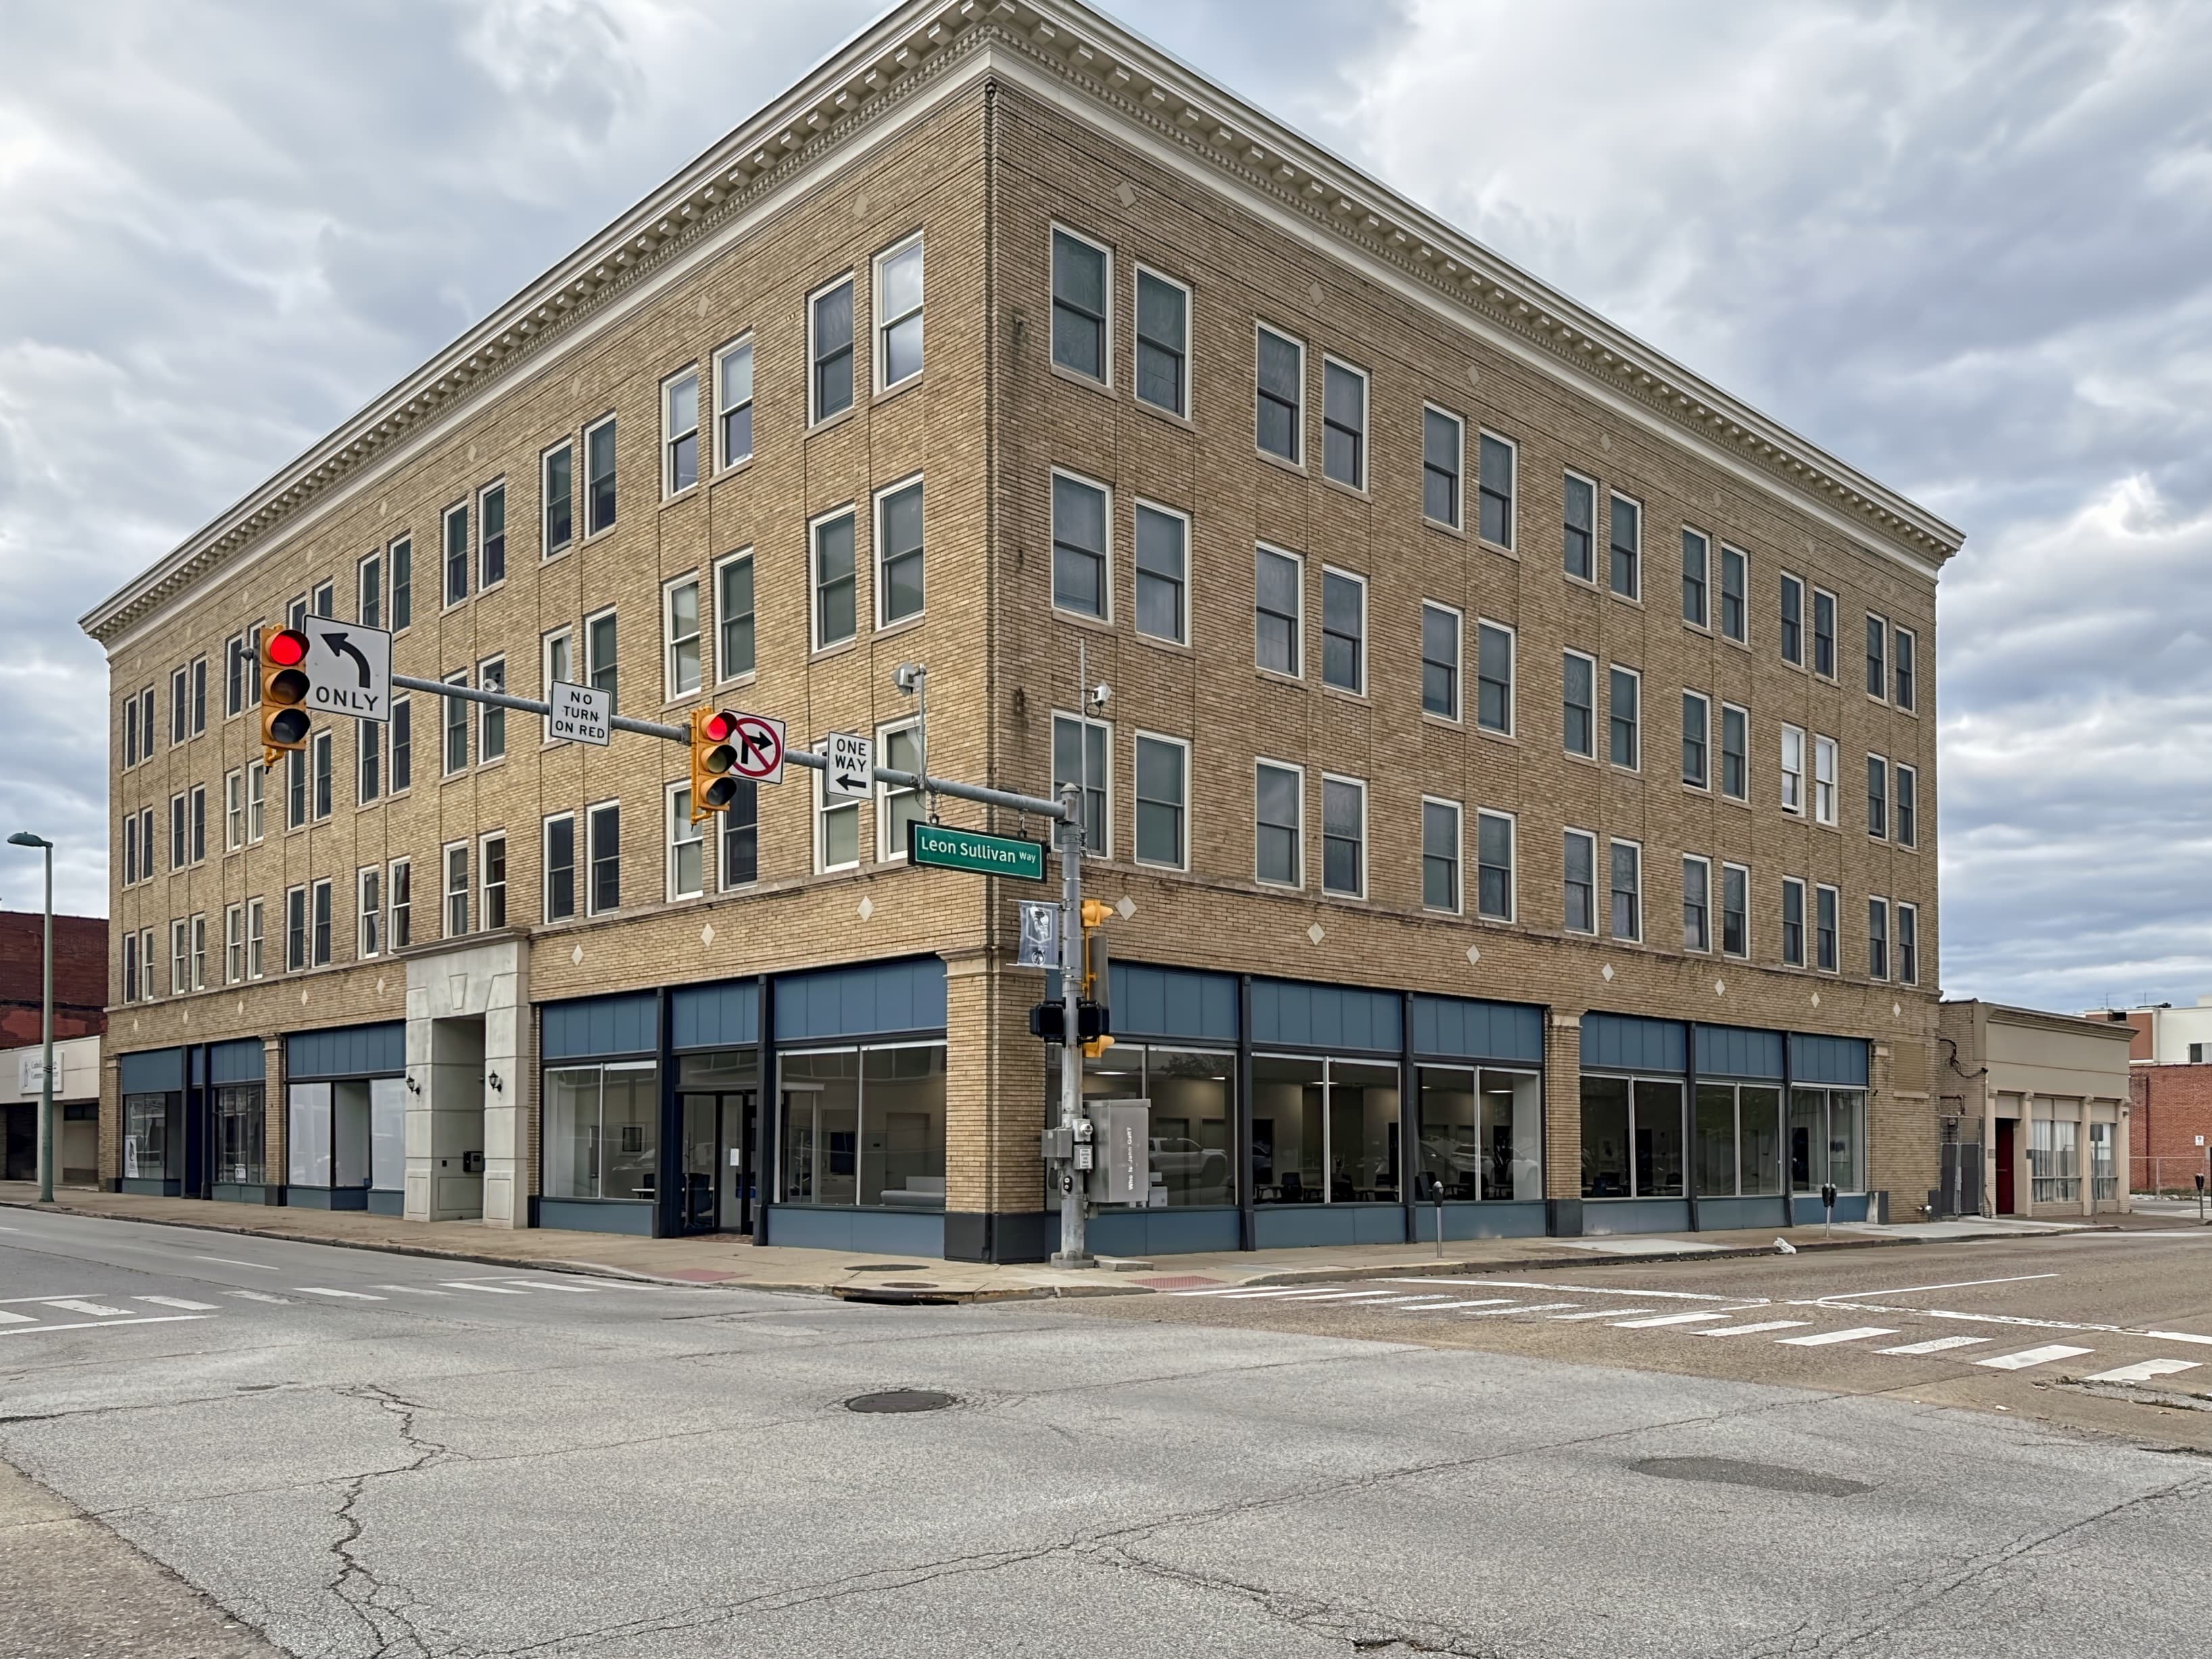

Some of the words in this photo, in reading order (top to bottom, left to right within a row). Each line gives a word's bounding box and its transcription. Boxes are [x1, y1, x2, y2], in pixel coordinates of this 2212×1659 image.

[316, 686, 379, 712] ONLY
[571, 691, 592, 705] NO
[563, 705, 598, 722] TURN
[556, 720, 573, 733] ON
[579, 724, 605, 738] RED
[836, 738, 867, 756] ONE
[835, 754, 867, 772] WAY
[921, 836, 957, 855] Leon
[960, 842, 1016, 863] Sullivan
[1019, 851, 1036, 864] Way
